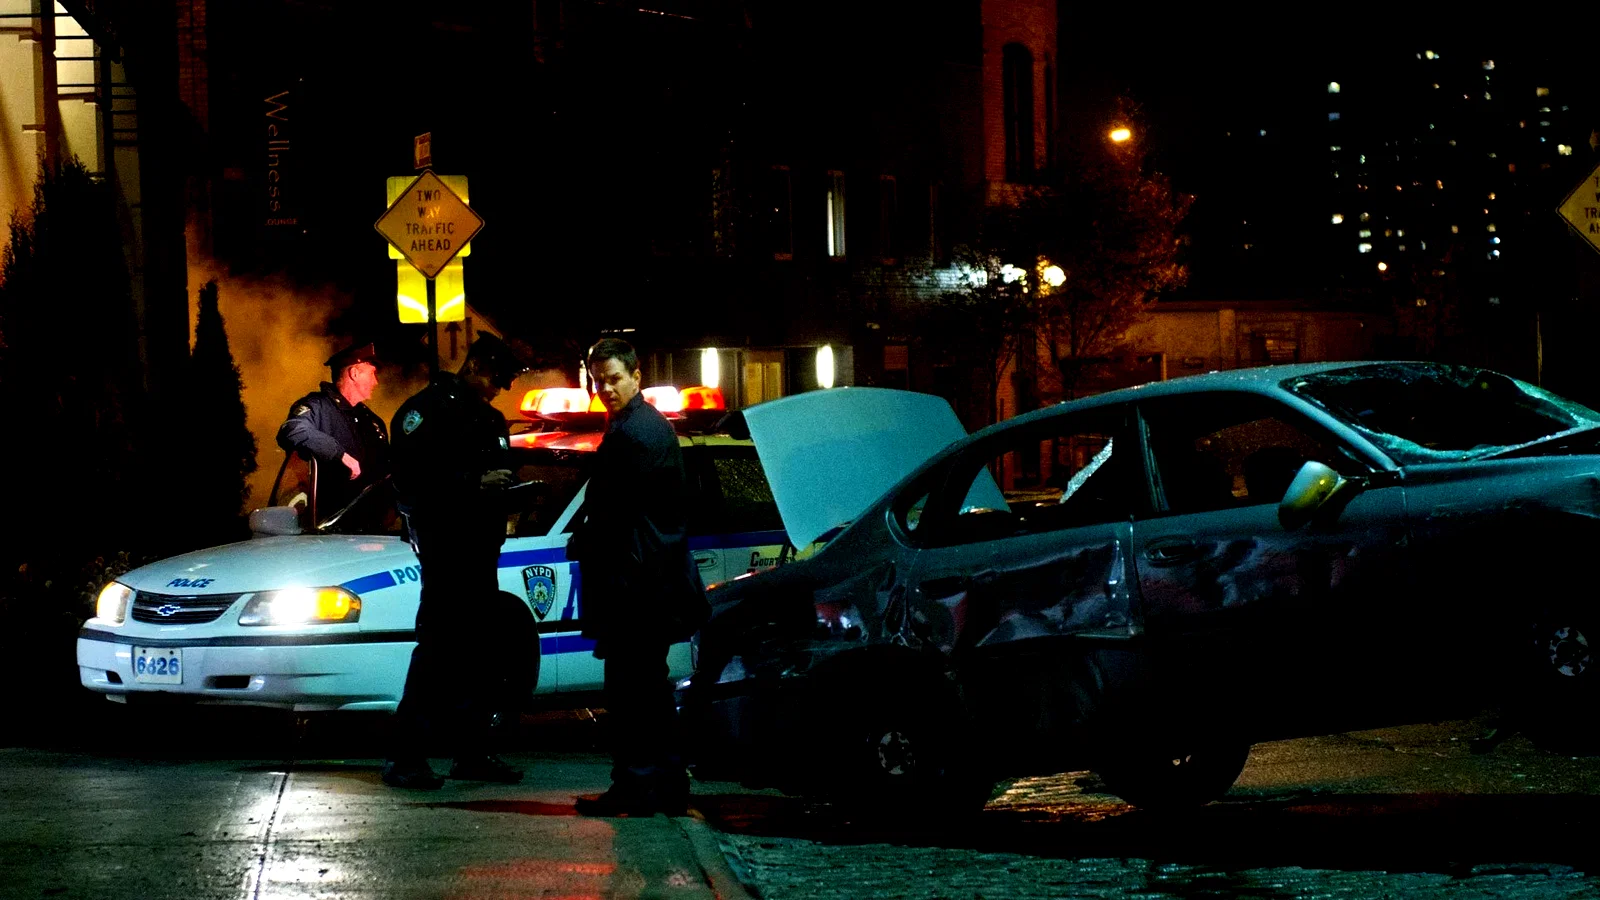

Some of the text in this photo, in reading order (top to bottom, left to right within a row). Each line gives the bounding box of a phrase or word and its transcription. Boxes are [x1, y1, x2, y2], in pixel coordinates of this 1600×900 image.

[264, 90, 290, 212] Wellness
[417, 190, 440, 201] TWO
[417, 206, 440, 218] WAY
[264, 218, 299, 226] OUNGE
[406, 222, 454, 235] TRAFFIC
[411, 239, 451, 251] AHEAD
[525, 566, 552, 579] NYPD
[166, 578, 215, 588] POLICE
[137, 656, 180, 675] 6826
